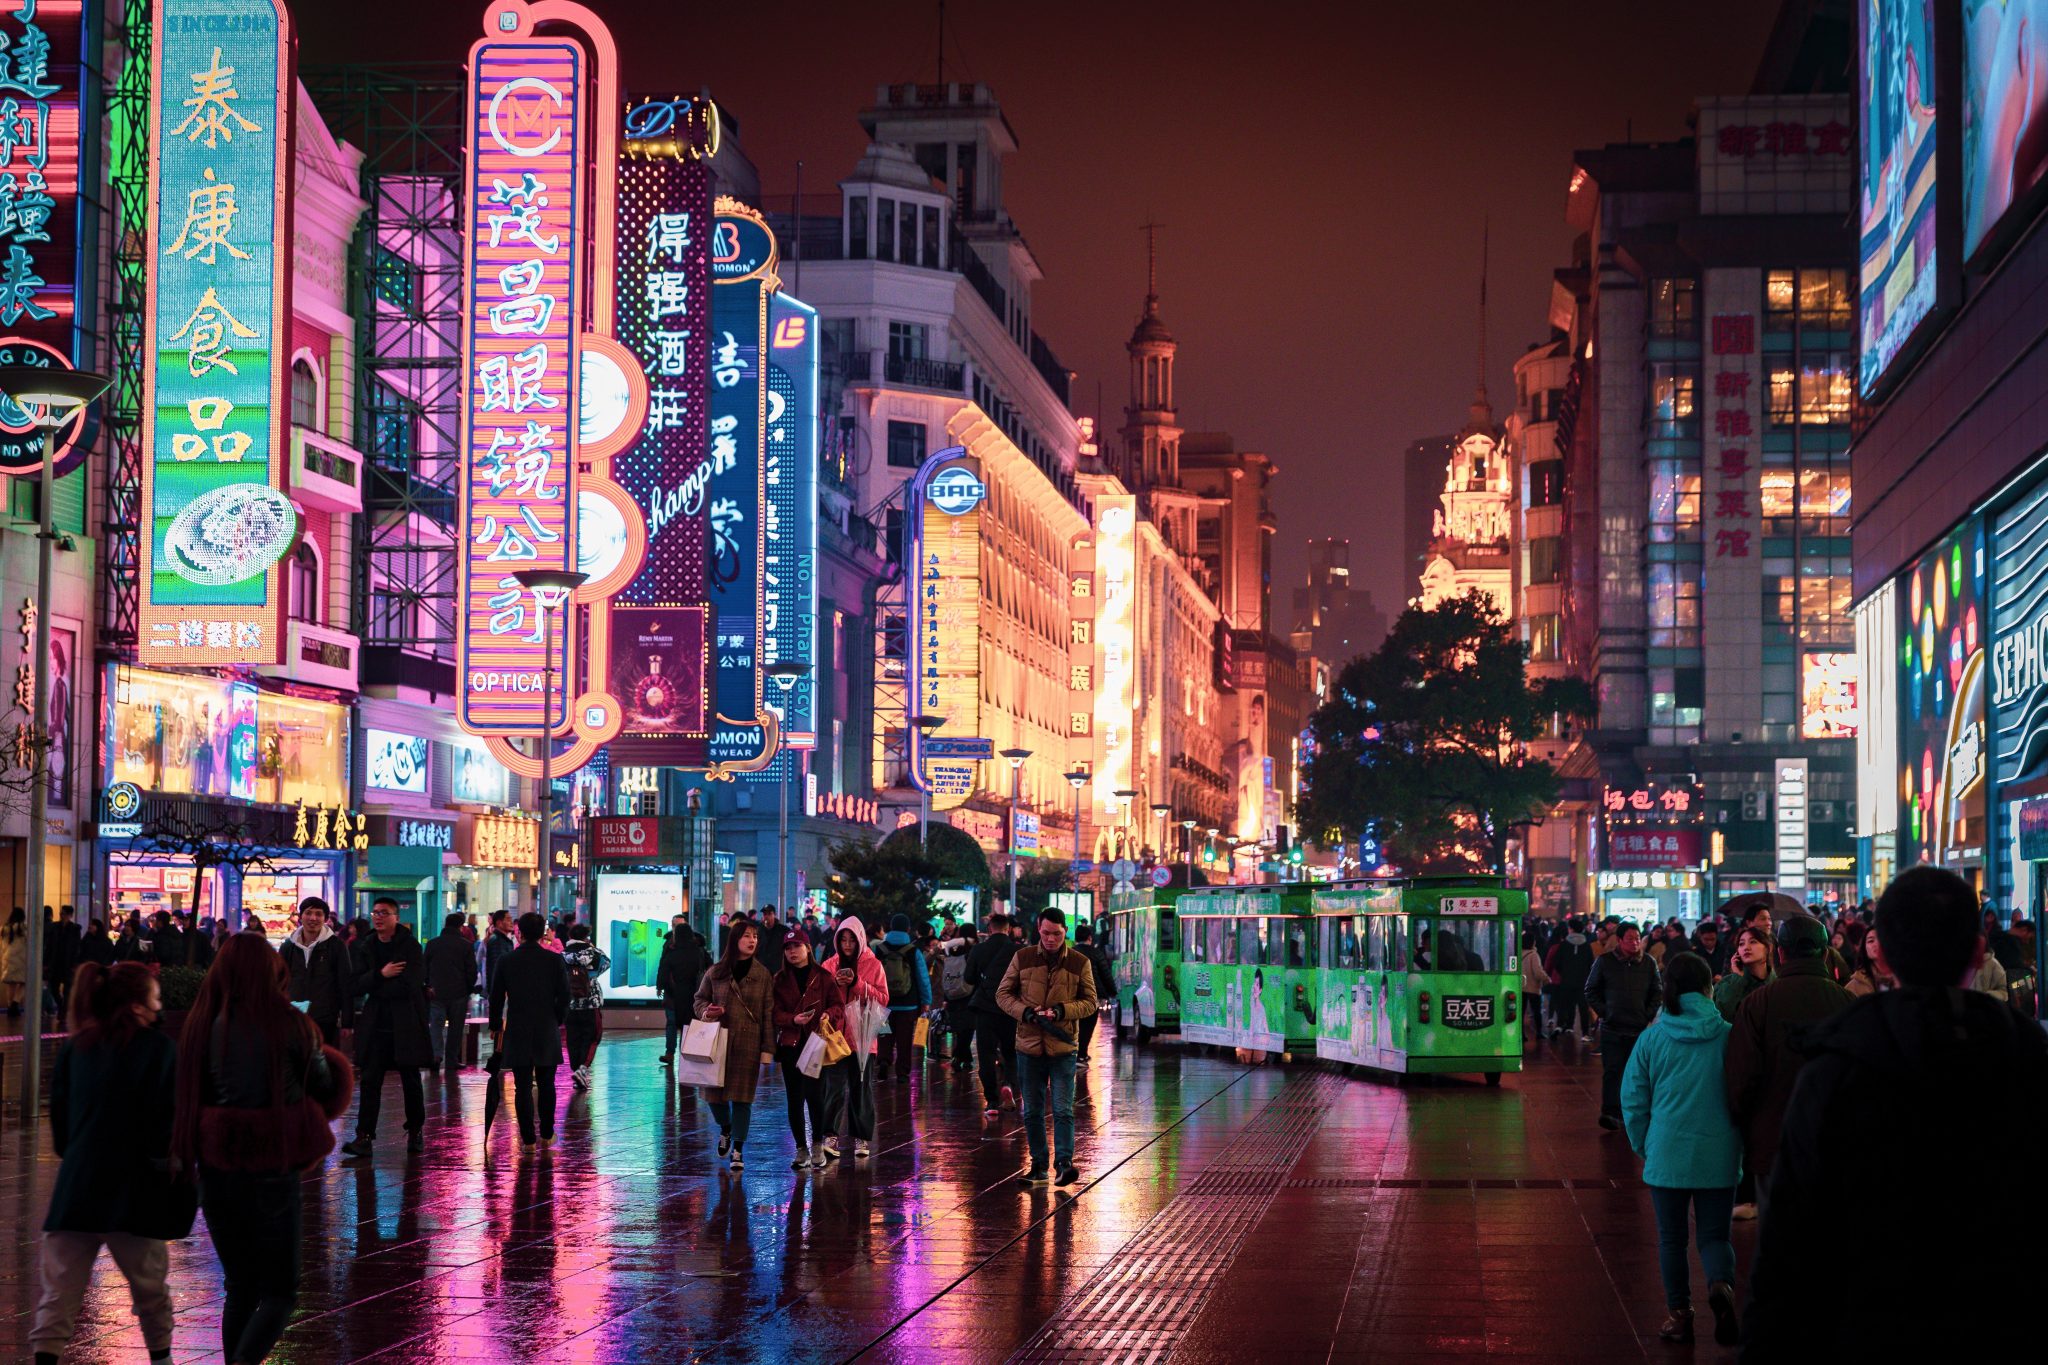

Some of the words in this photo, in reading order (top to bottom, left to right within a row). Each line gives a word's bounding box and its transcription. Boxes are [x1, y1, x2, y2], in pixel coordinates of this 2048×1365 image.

[165, 46, 262, 462] 泰康食品
[929, 485, 983, 498] BAC
[798, 554, 812, 601] No.1
[797, 614, 812, 718] Pharacy
[472, 672, 556, 692] OPTICA
[719, 749, 752, 757] WEAR
[294, 801, 369, 849] 泰康食品
[601, 823, 626, 835] BUS
[601, 836, 626, 845] TOUR
[1459, 899, 1492, 908] 观光车
[1510, 957, 1516, 970] 8
[1446, 999, 1491, 1020] 豆本豆
